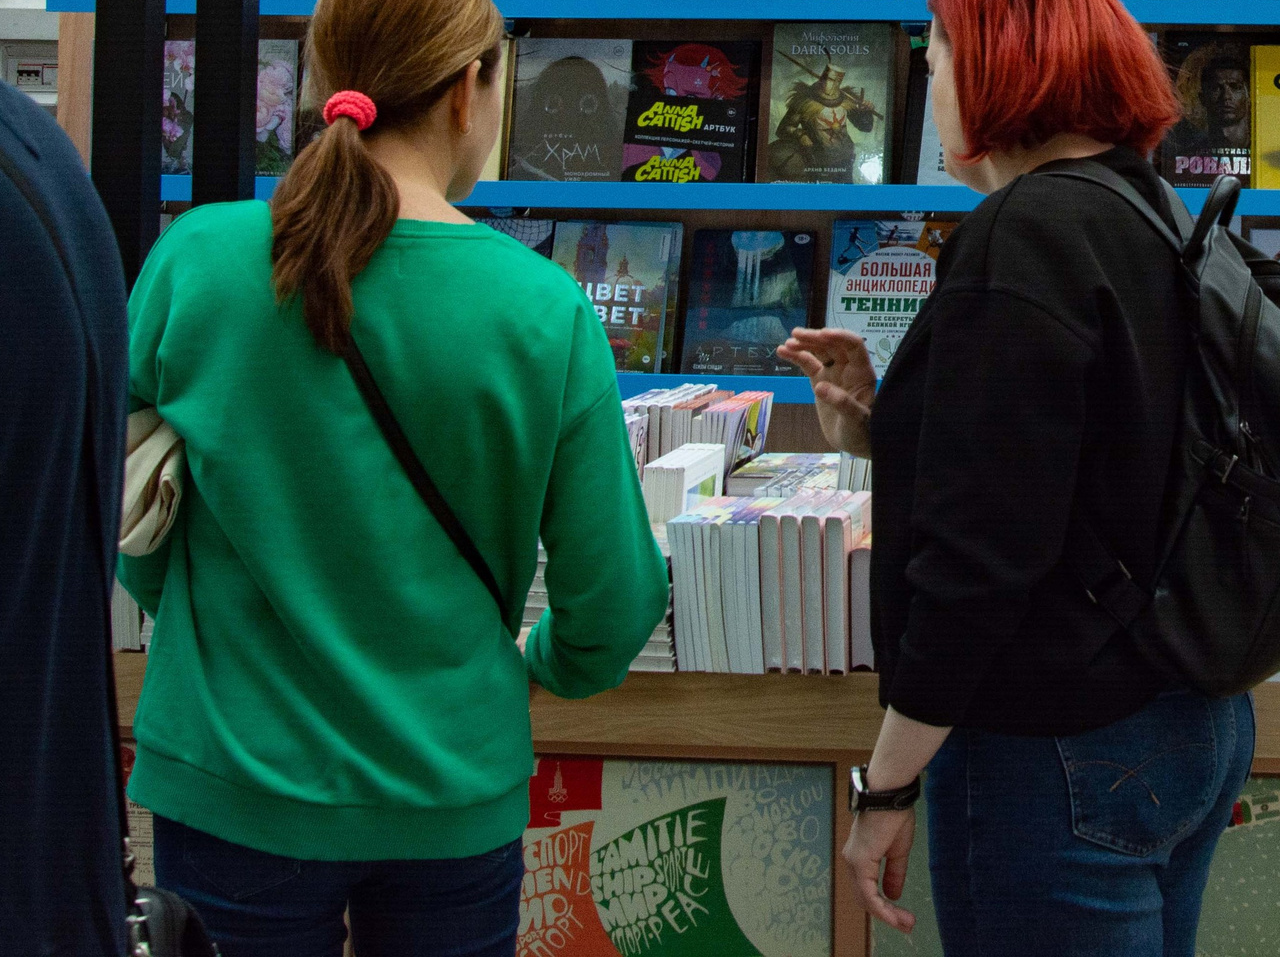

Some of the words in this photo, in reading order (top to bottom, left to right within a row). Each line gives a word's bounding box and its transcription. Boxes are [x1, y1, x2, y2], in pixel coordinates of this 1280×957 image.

[802, 32, 859, 42] Мифология
[792, 45, 826, 55] DARK
[829, 45, 870, 55] SOULS
[649, 101, 698, 116] ANNA
[703, 124, 736, 133] АРТБУК
[645, 155, 696, 168] ANNA
[860, 262, 932, 278] БОЛЬШАЯ
[846, 279, 937, 294] ЭНЦИКЛОПЕДИ
[590, 809, 710, 870] L'AMITIE
[654, 847, 688, 894] SPORT
[591, 865, 656, 901] SHIP
[600, 883, 668, 932] МИР
